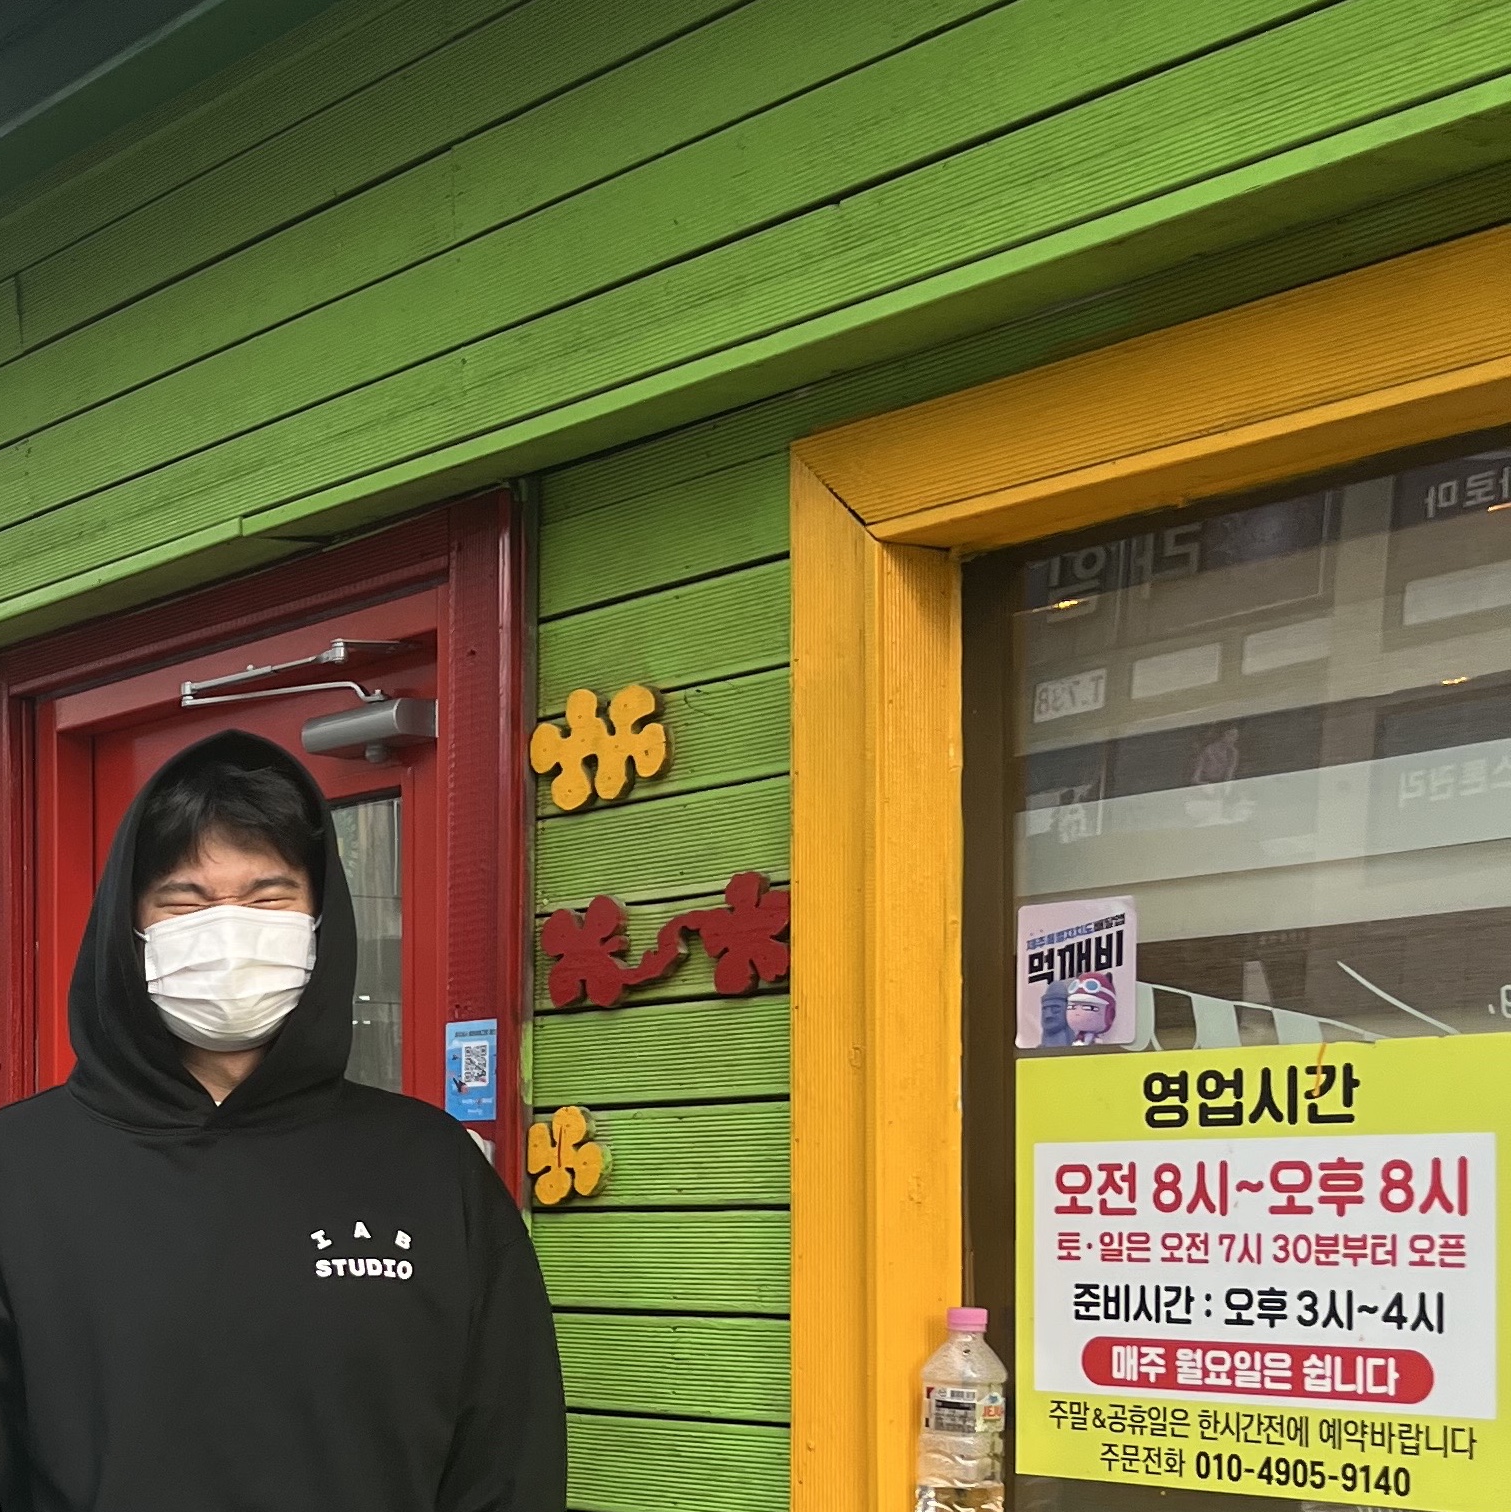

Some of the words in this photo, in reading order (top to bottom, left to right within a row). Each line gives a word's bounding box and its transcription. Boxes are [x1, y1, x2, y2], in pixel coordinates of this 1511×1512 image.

[1028, 929, 1124, 985] 먹깨비
[1142, 1062, 1361, 1129] 영업시간
[1054, 1161, 1137, 1217] 오전
[1379, 1155, 1469, 1217] 8시
[315, 1258, 414, 1280] STUDIO
[1160, 1231, 1210, 1265] 오전
[1217, 1231, 1262, 1266] 7시
[1272, 1231, 1398, 1267] 30분부터
[1408, 1231, 1467, 1269] 오픈
[1224, 1286, 1288, 1328] 오후
[1296, 1288, 1445, 1335] 3시~4시
[1111, 1344, 1167, 1383] 매주
[1175, 1347, 1293, 1391] 월요일은
[1302, 1352, 1400, 1397] 쉽니다
[1197, 1408, 1310, 1449] 한시간전에
[1319, 1418, 1478, 1461] 예약바랍니다
[1100, 1442, 1186, 1478] 주문전화
[1195, 1450, 1411, 1497] 010-4905-9140
